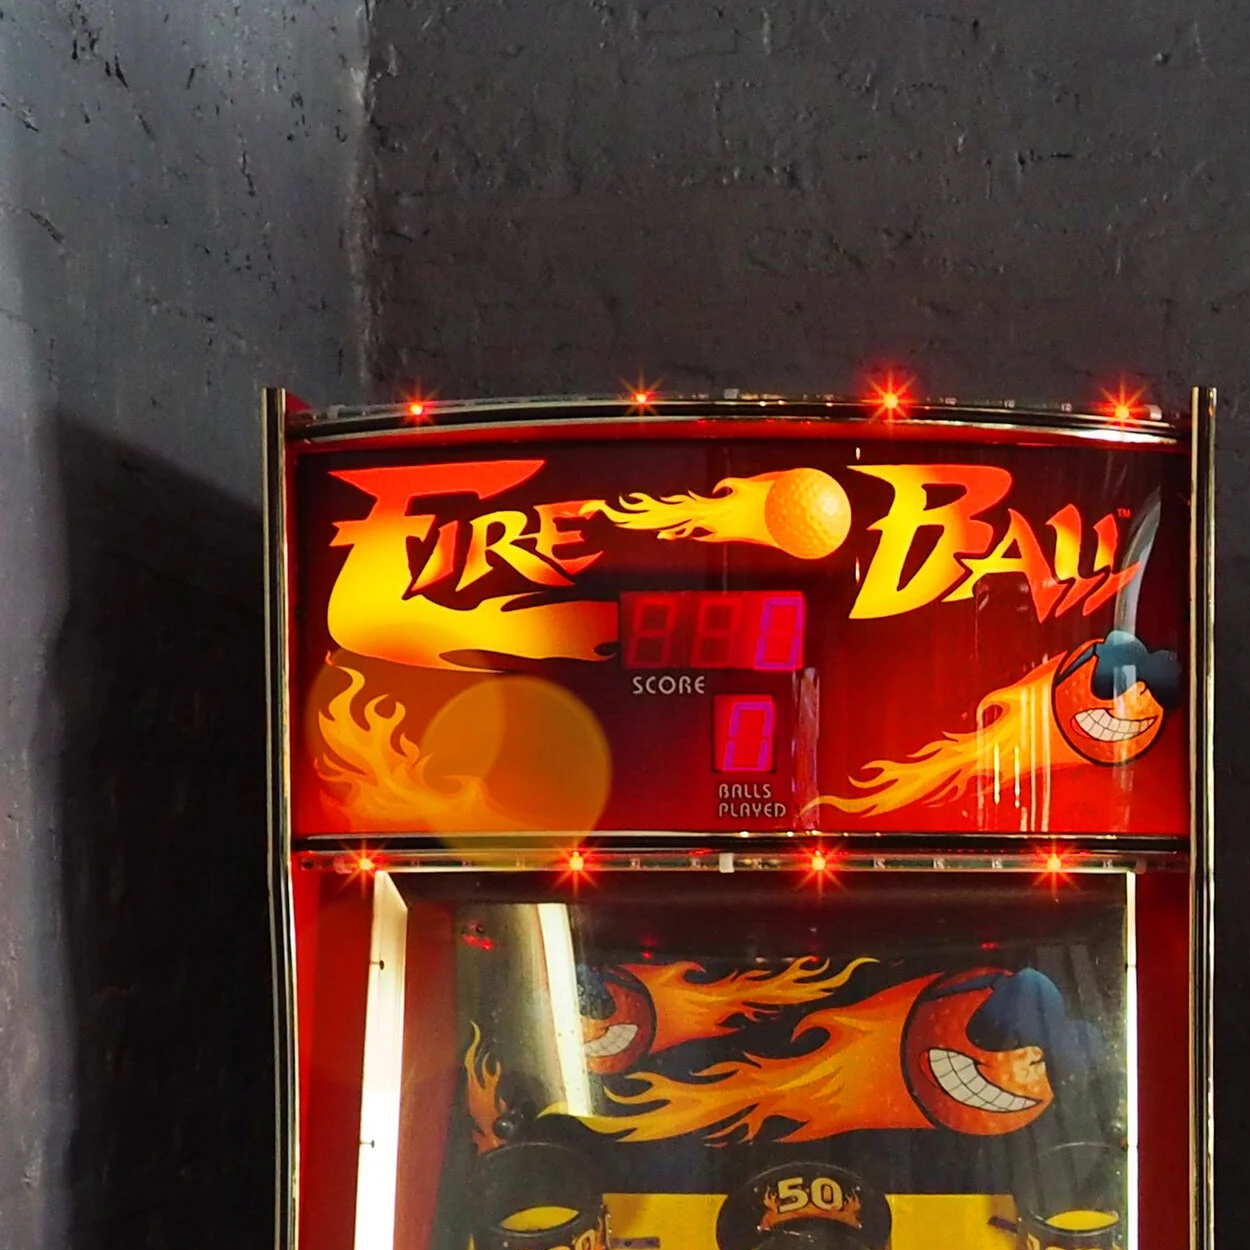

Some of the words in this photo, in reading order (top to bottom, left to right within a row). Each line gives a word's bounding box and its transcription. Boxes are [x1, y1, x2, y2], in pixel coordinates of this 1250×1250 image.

[632, 675, 706, 695] SCORE
[722, 700, 774, 772] 0
[718, 783, 772, 799] BALLS
[718, 802, 787, 818] PLAYED
[776, 1176, 844, 1215] 50
